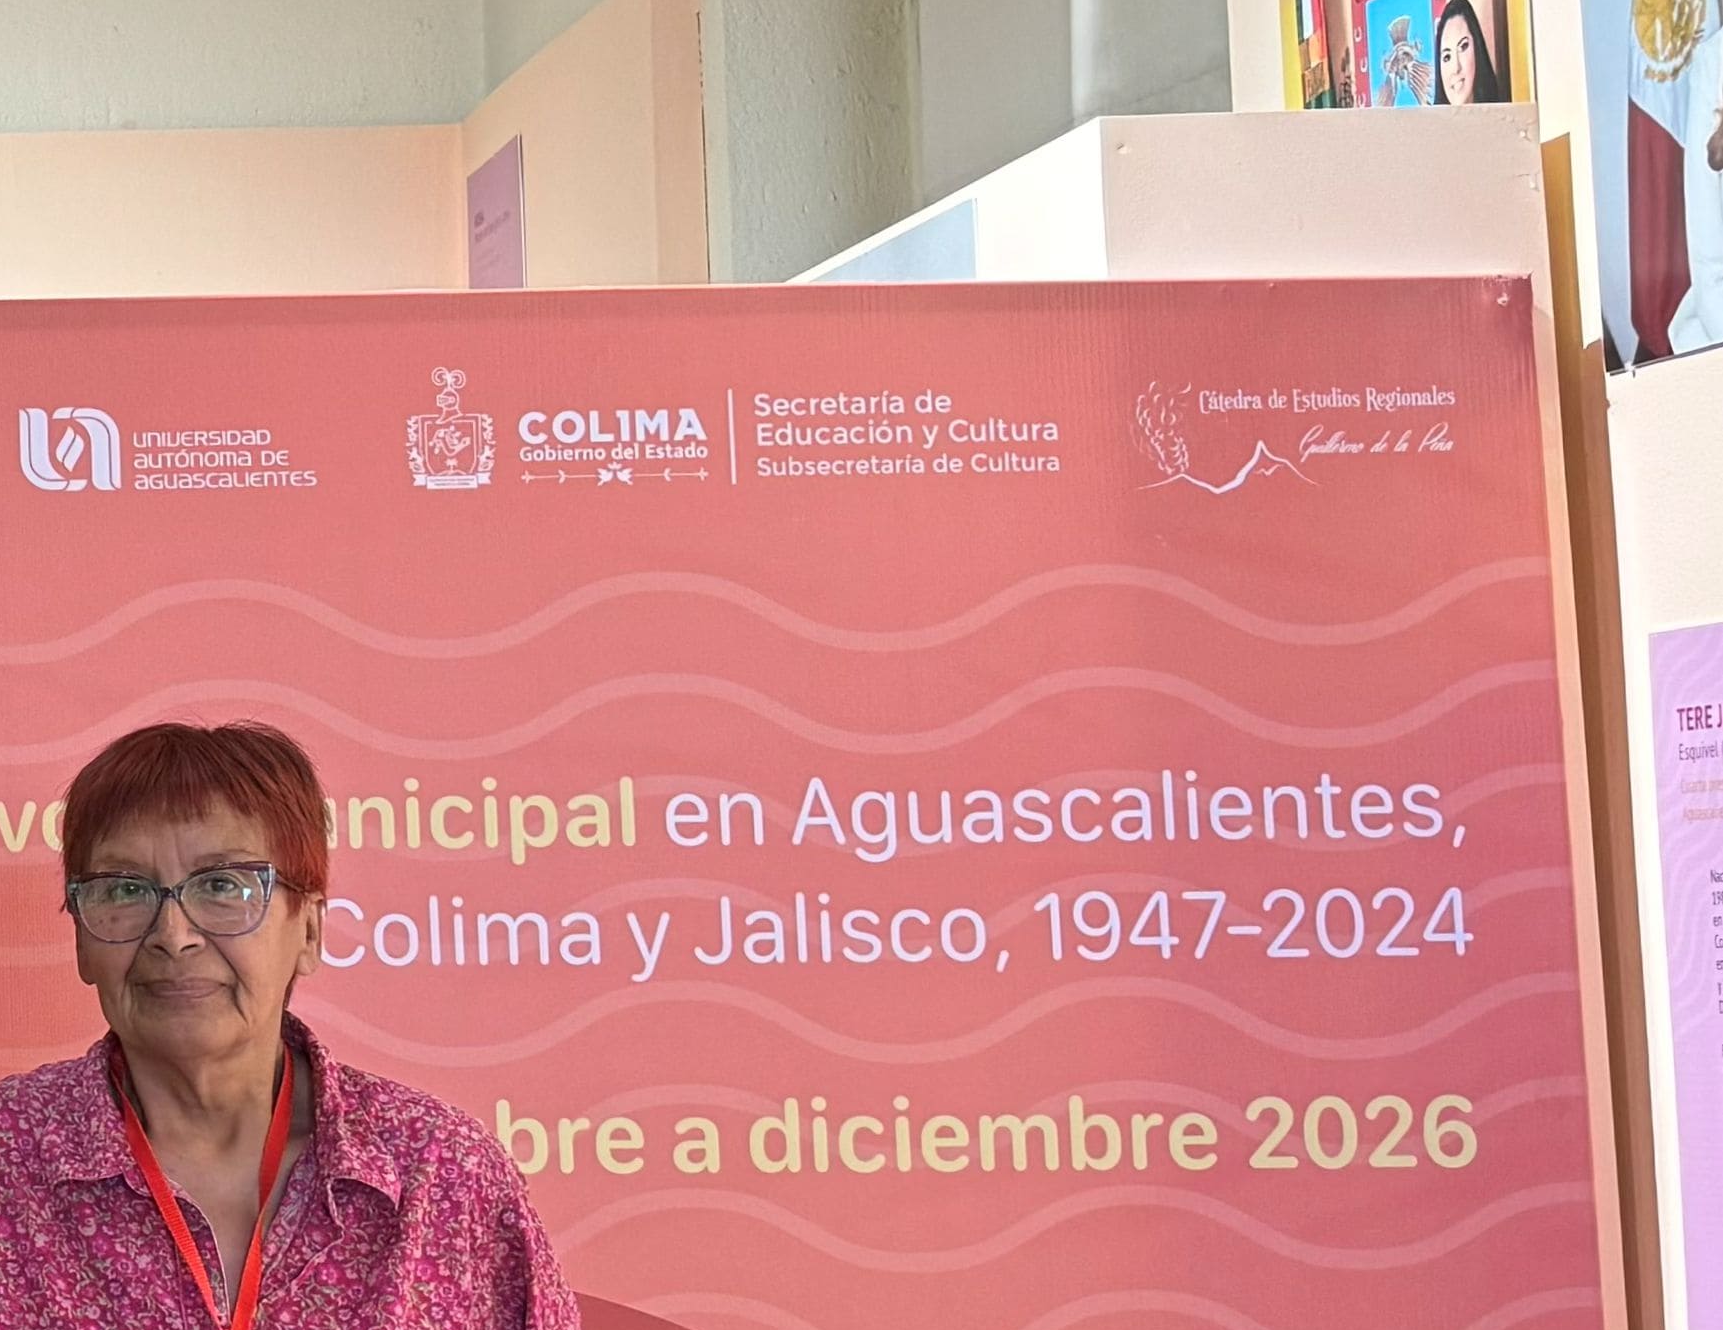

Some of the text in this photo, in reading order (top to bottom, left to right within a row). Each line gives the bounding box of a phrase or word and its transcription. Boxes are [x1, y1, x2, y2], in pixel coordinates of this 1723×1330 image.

[754, 389, 952, 417] Secretaría de
[1199, 385, 1455, 415] Cátedra de Estudios Regionales
[518, 407, 708, 445] COLIMA
[756, 417, 1059, 447] Educación y Cultura
[519, 442, 708, 464] Gobierno del Estado
[1370, 431, 1390, 454] de
[1394, 429, 1412, 453] la
[260, 450, 290, 467] DE
[756, 449, 1061, 477] Subsecretaría de Cultura
[1677, 705, 1713, 731] TERE
[1679, 740, 1719, 763] Esquivel
[326, 773, 637, 864] nicipal
[664, 788, 765, 848] en
[791, 768, 1469, 860] Aguascalientes,
[317, 892, 603, 967] Colima
[625, 910, 674, 982] y
[694, 890, 1014, 982] Jalisco,
[674, 1117, 721, 1175] a
[749, 1095, 1216, 1174] diciembre
[1244, 1090, 1479, 1172] 2026
